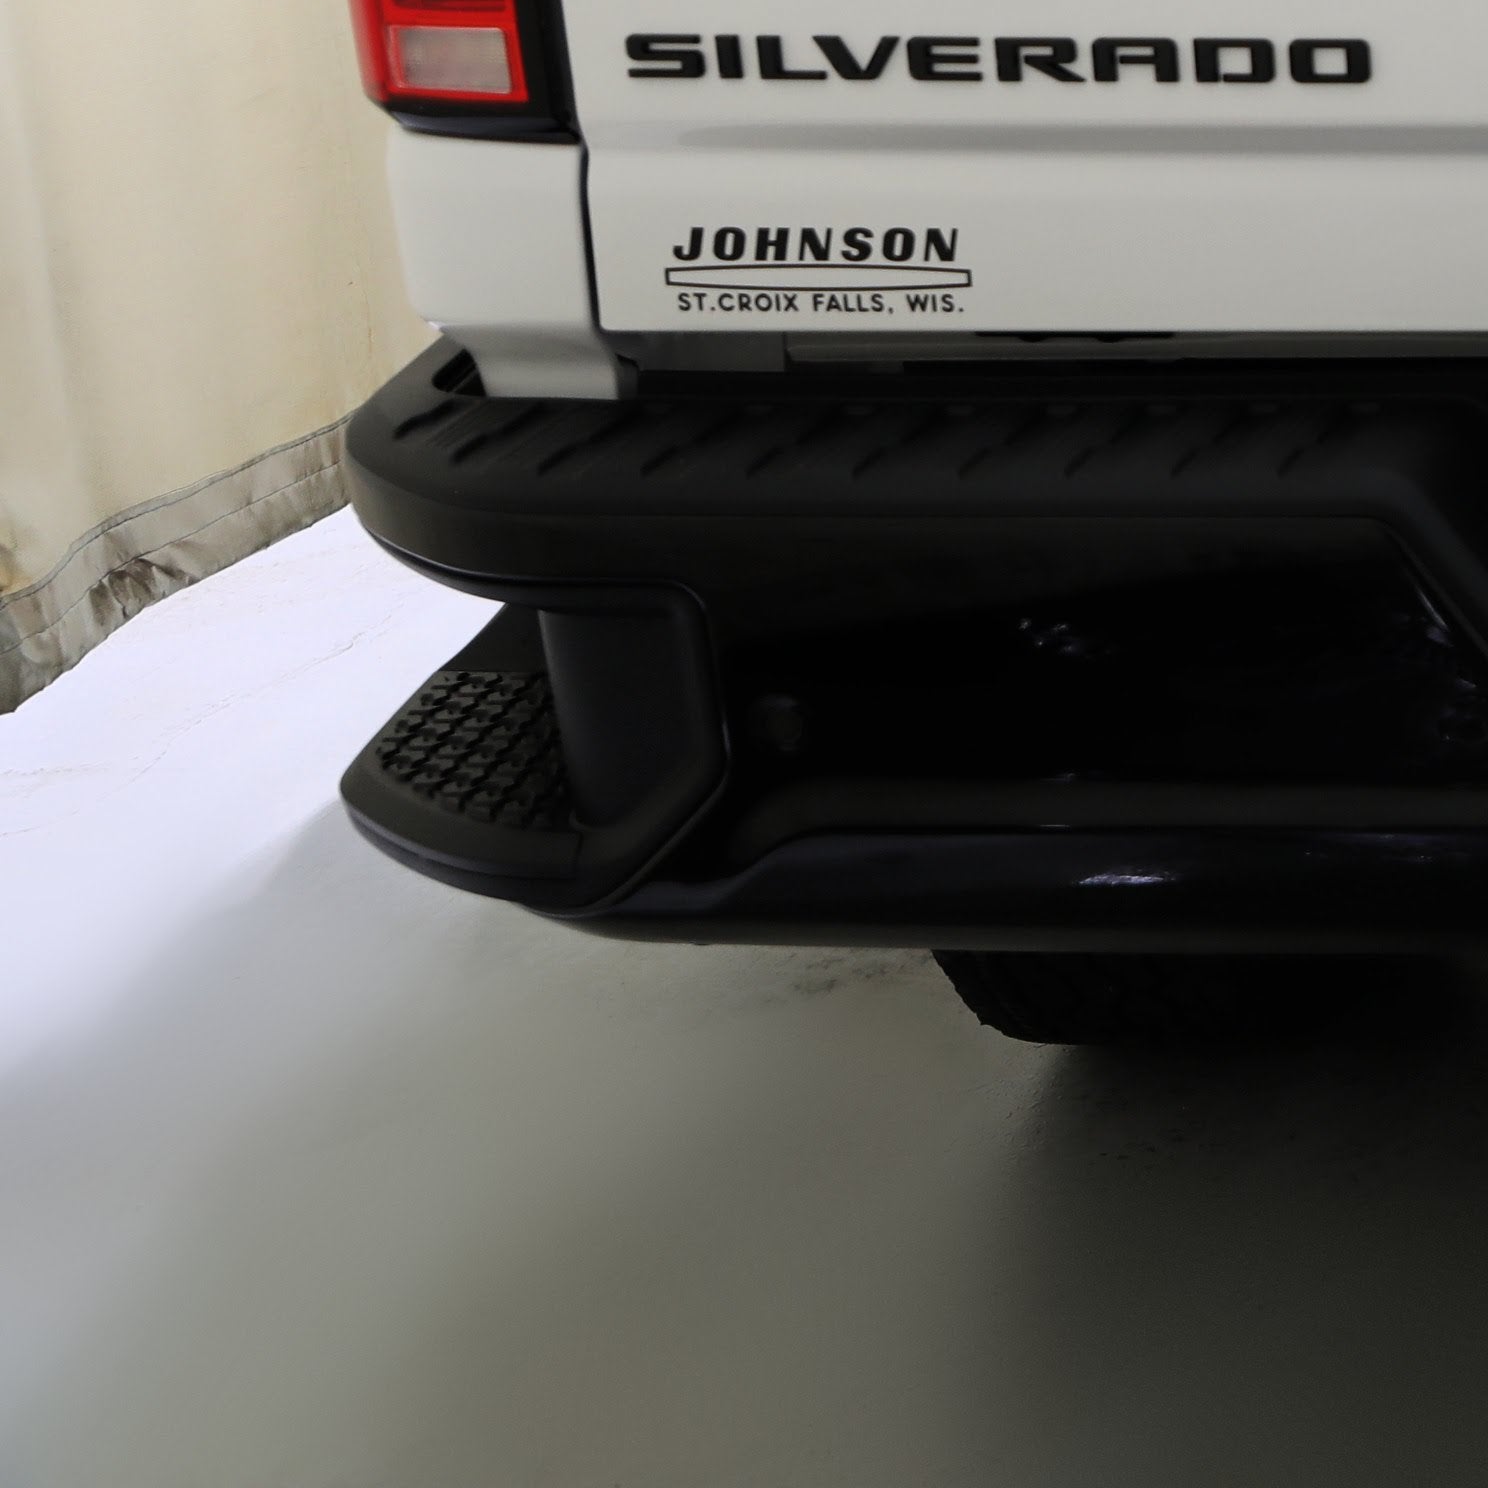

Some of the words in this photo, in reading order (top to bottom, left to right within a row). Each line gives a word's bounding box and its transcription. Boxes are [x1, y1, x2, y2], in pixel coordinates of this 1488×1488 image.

[624, 33, 1372, 85] SILVERADO
[673, 226, 959, 262] JOHNSON
[812, 293, 894, 314] FALLS,
[906, 294, 965, 313] WIS.
